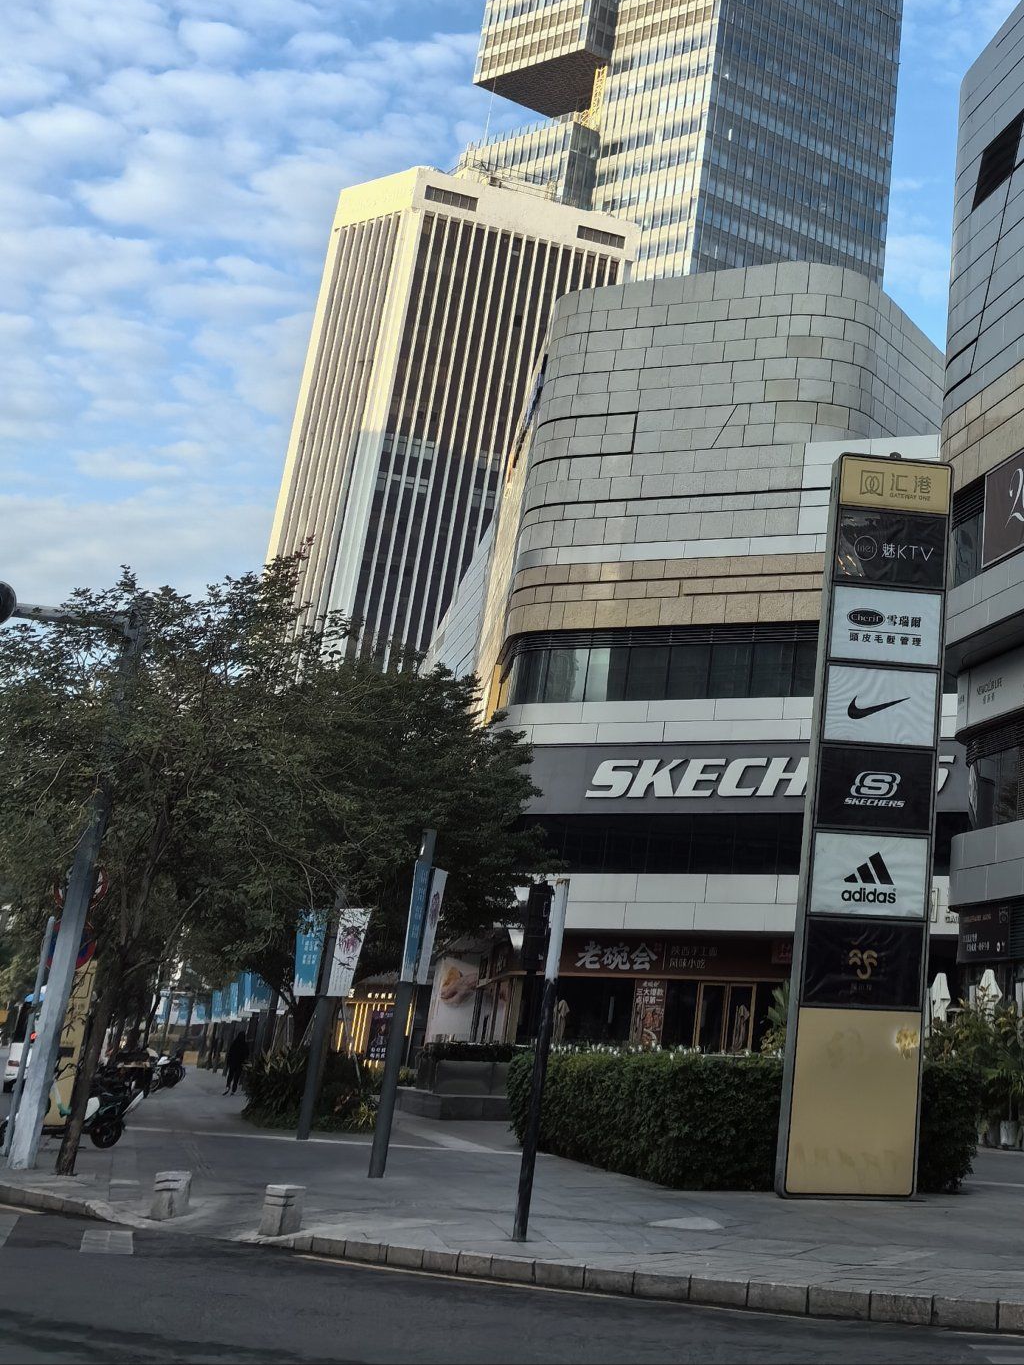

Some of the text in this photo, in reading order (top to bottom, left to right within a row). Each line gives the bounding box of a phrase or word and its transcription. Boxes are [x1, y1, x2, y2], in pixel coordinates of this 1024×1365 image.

[890, 473, 932, 494] 汇港
[881, 542, 934, 562] 魅KTV
[585, 755, 956, 798] SKECH
[843, 797, 906, 808] SKECHERS
[841, 887, 896, 904] adidas
[574, 940, 658, 971] 老碗会
